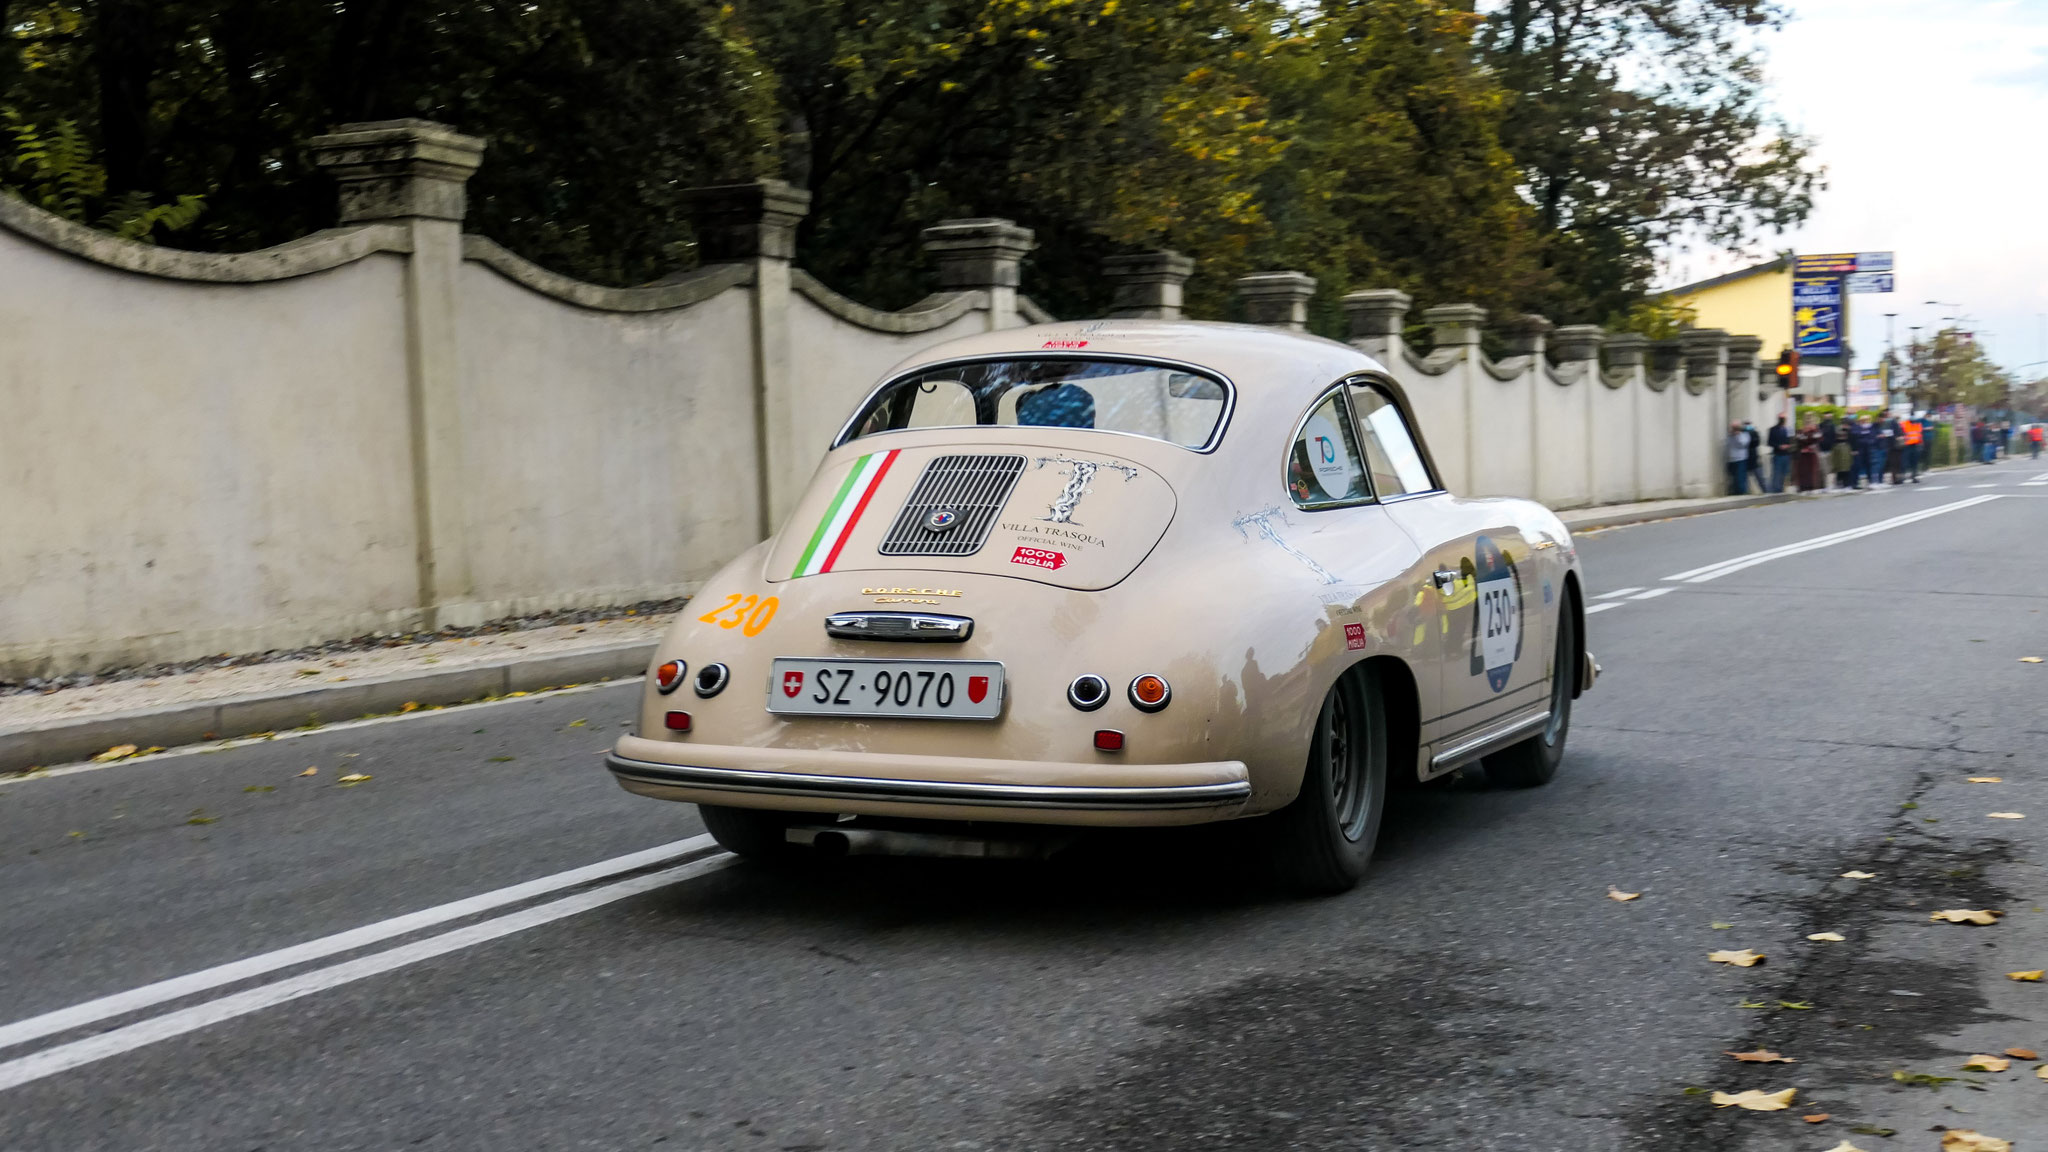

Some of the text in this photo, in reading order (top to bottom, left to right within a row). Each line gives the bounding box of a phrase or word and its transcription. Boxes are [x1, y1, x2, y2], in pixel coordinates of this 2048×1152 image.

[1002, 523, 1105, 548] VILLA TRASQUA
[1017, 535, 1083, 552] OFFICIAL WINE
[1020, 548, 1056, 560] 1000
[1013, 556, 1055, 569] MIGLIA
[862, 587, 963, 597] PORSCHE
[697, 593, 780, 638] 230
[1485, 588, 1512, 638] 230
[1346, 626, 1362, 636] 1000
